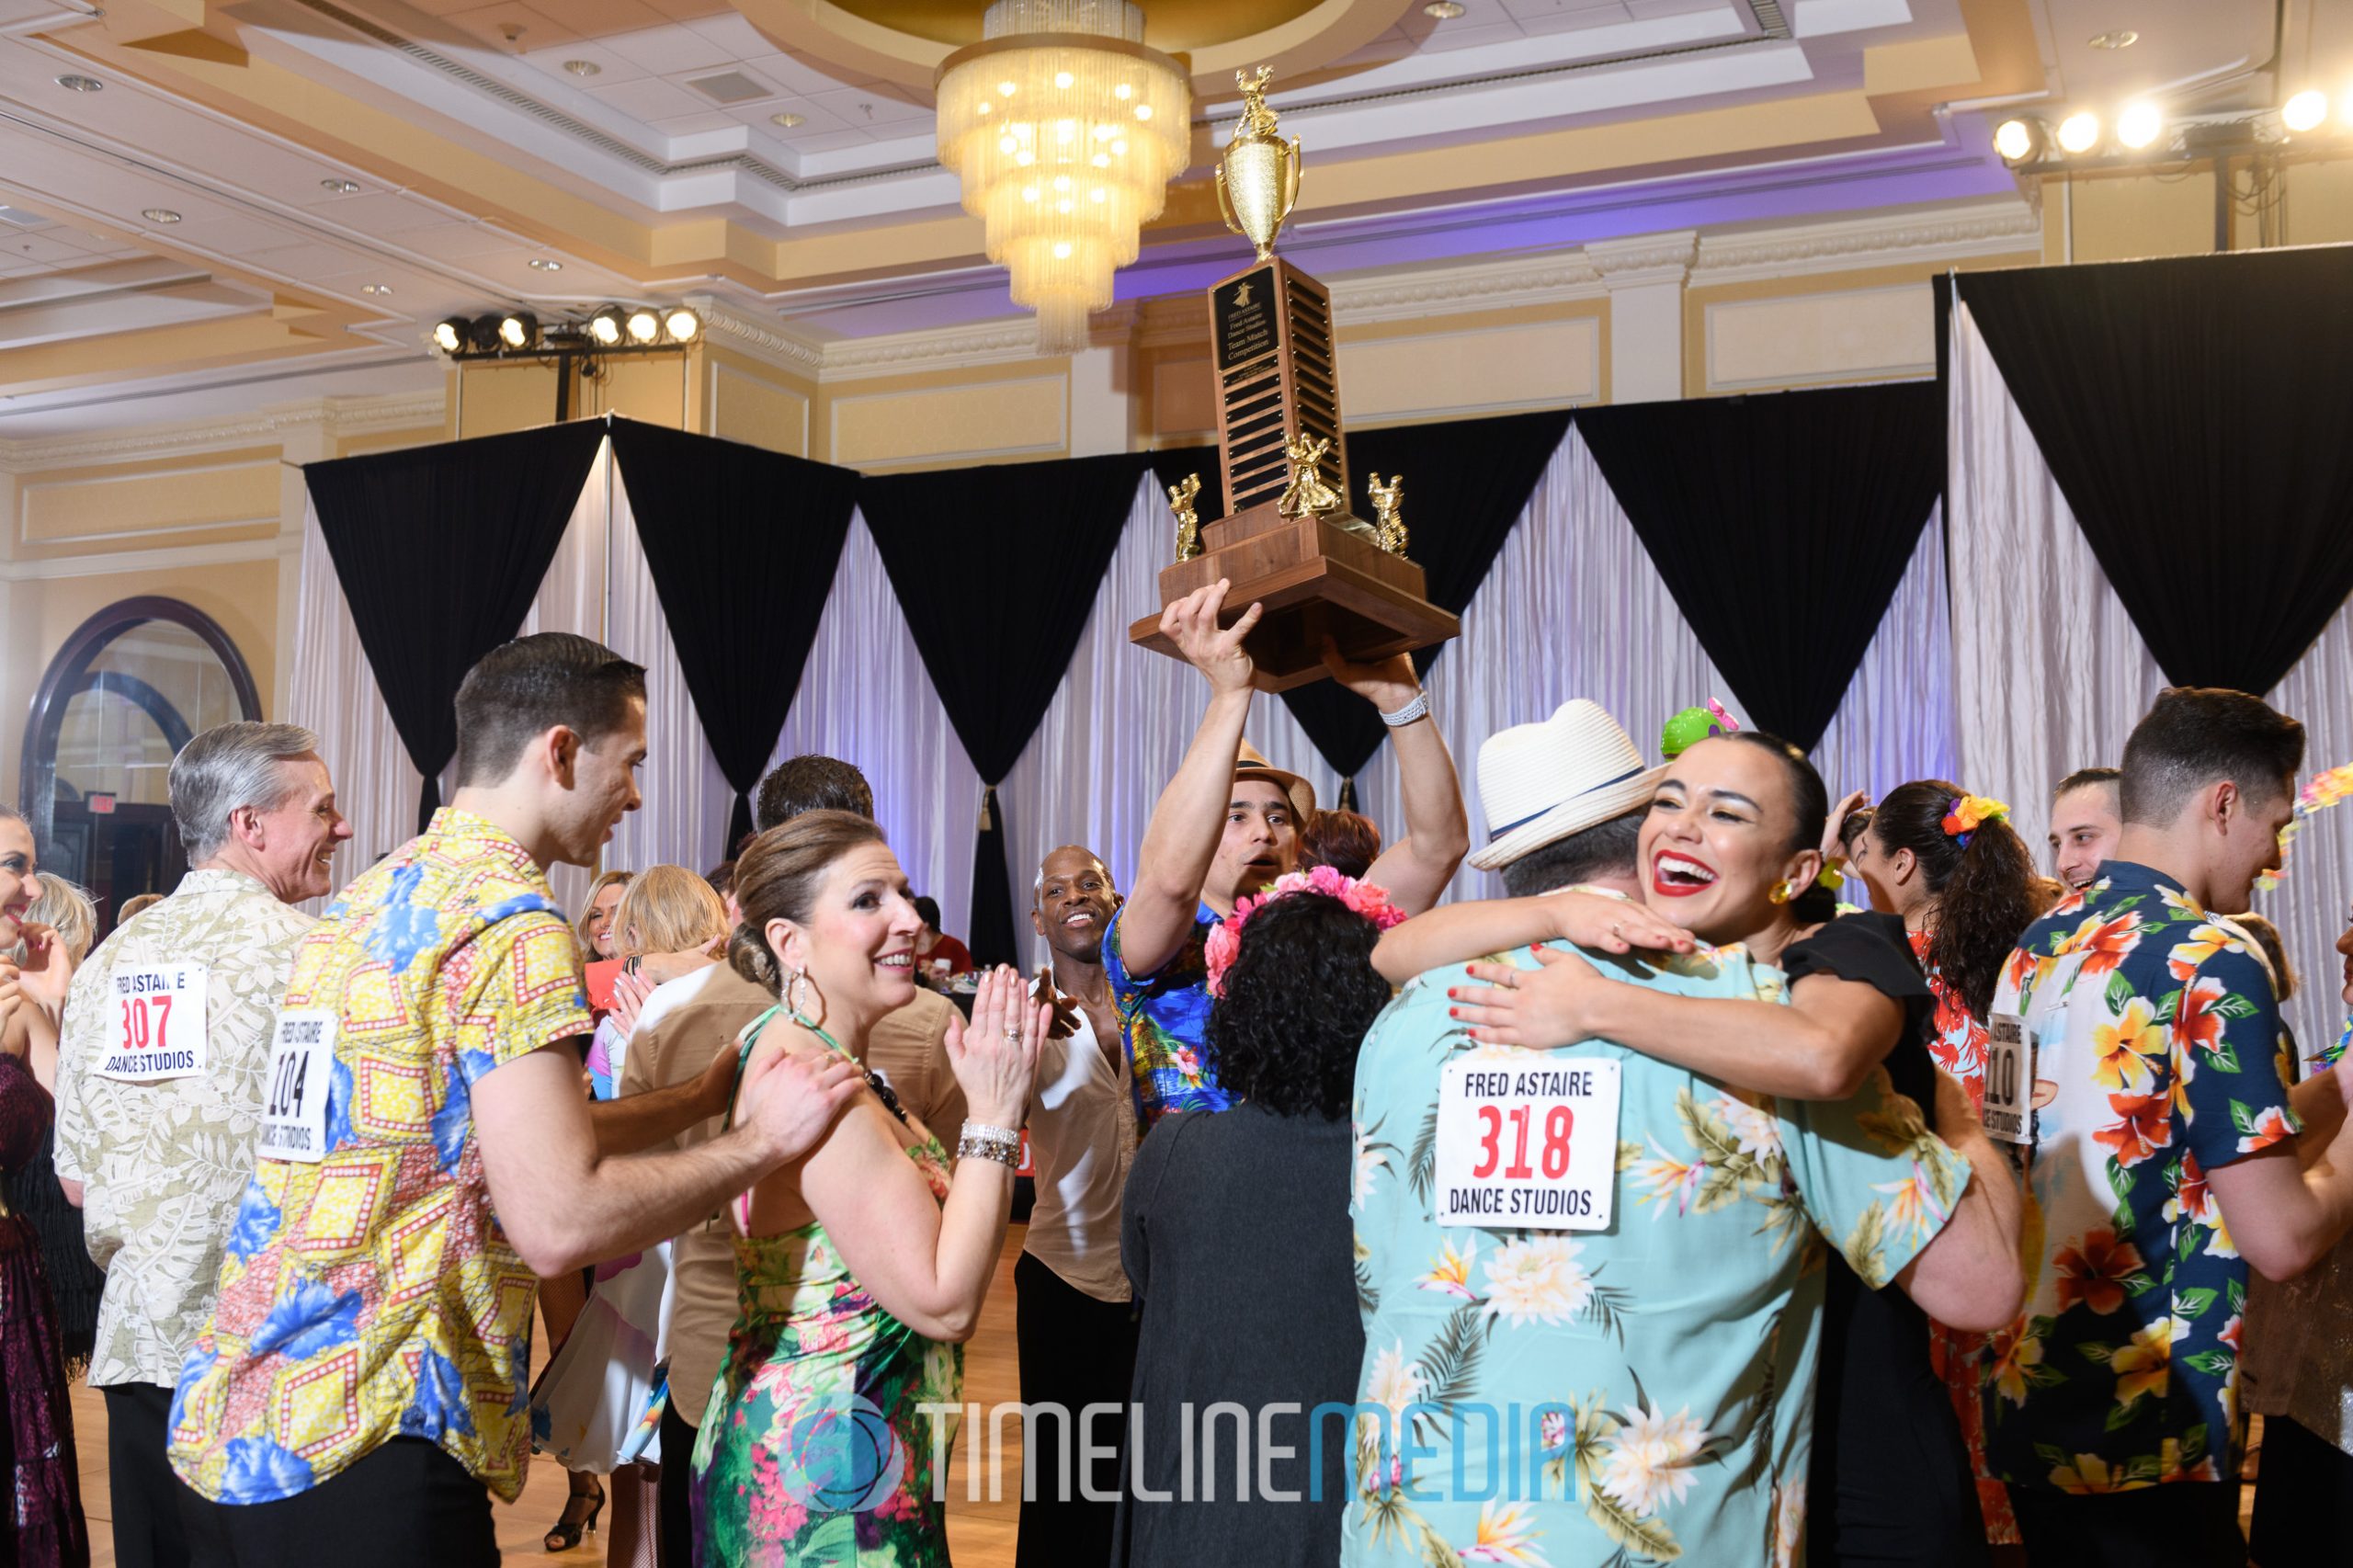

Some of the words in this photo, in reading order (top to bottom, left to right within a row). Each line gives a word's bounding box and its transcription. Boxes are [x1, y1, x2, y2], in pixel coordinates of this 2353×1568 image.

[1227, 339, 1245, 350] Team
[1246, 329, 1268, 342] Match
[1228, 340, 1268, 360] Competition
[121, 994, 172, 1050] 307
[105, 1054, 138, 1074] DANCE
[140, 1050, 195, 1073] STUDIOS
[269, 1051, 309, 1118] 104
[1465, 1073, 1508, 1097] FRED
[1514, 1071, 1593, 1097] ASTAIRE
[1991, 1109, 2022, 1134] STUDIOS
[1472, 1104, 1574, 1180] 318
[1450, 1187, 1504, 1214] DANCE
[1510, 1188, 1592, 1216] STUDIOS
